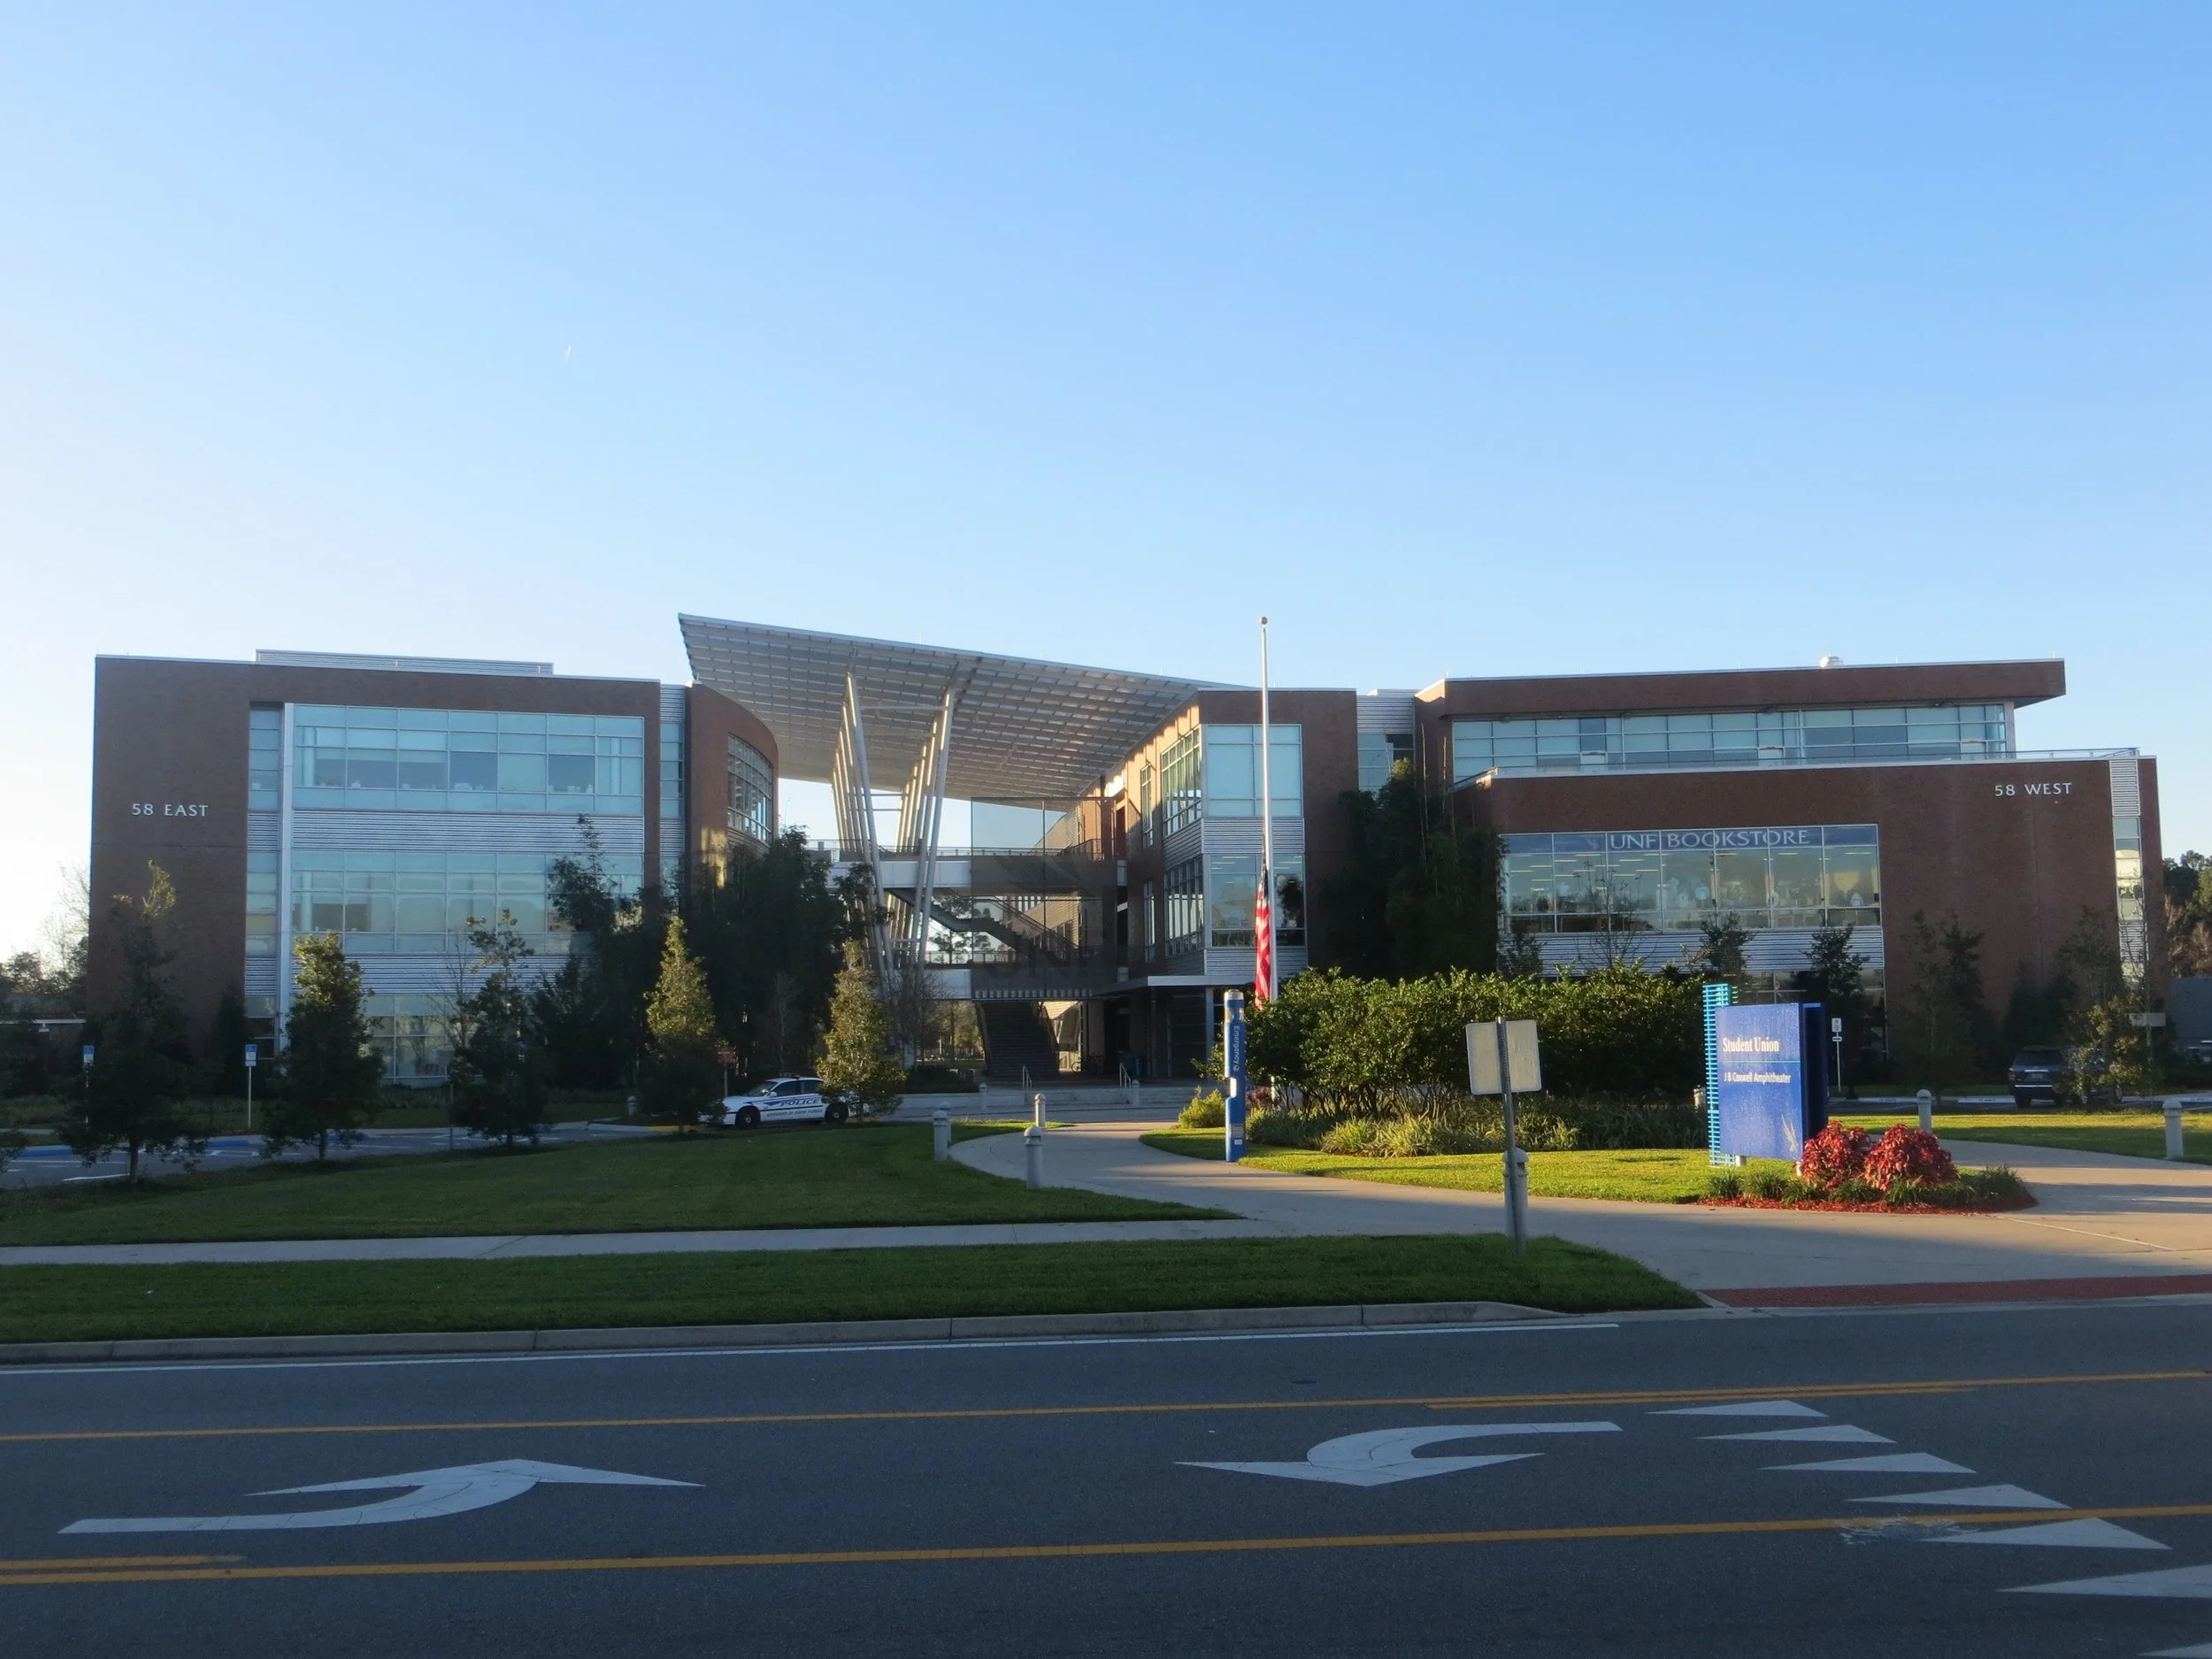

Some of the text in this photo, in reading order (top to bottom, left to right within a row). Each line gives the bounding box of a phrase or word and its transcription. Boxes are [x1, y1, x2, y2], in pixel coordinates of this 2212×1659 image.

[1994, 782, 2072, 797] 58 WEST
[132, 803, 209, 817] 58 EAST
[1610, 830, 1810, 849] UNF BOOKSTORE
[1723, 1036, 1779, 1052] Student Union
[1754, 1072, 1791, 1085] Amphitheater
[780, 1097, 819, 1107] POLICE
